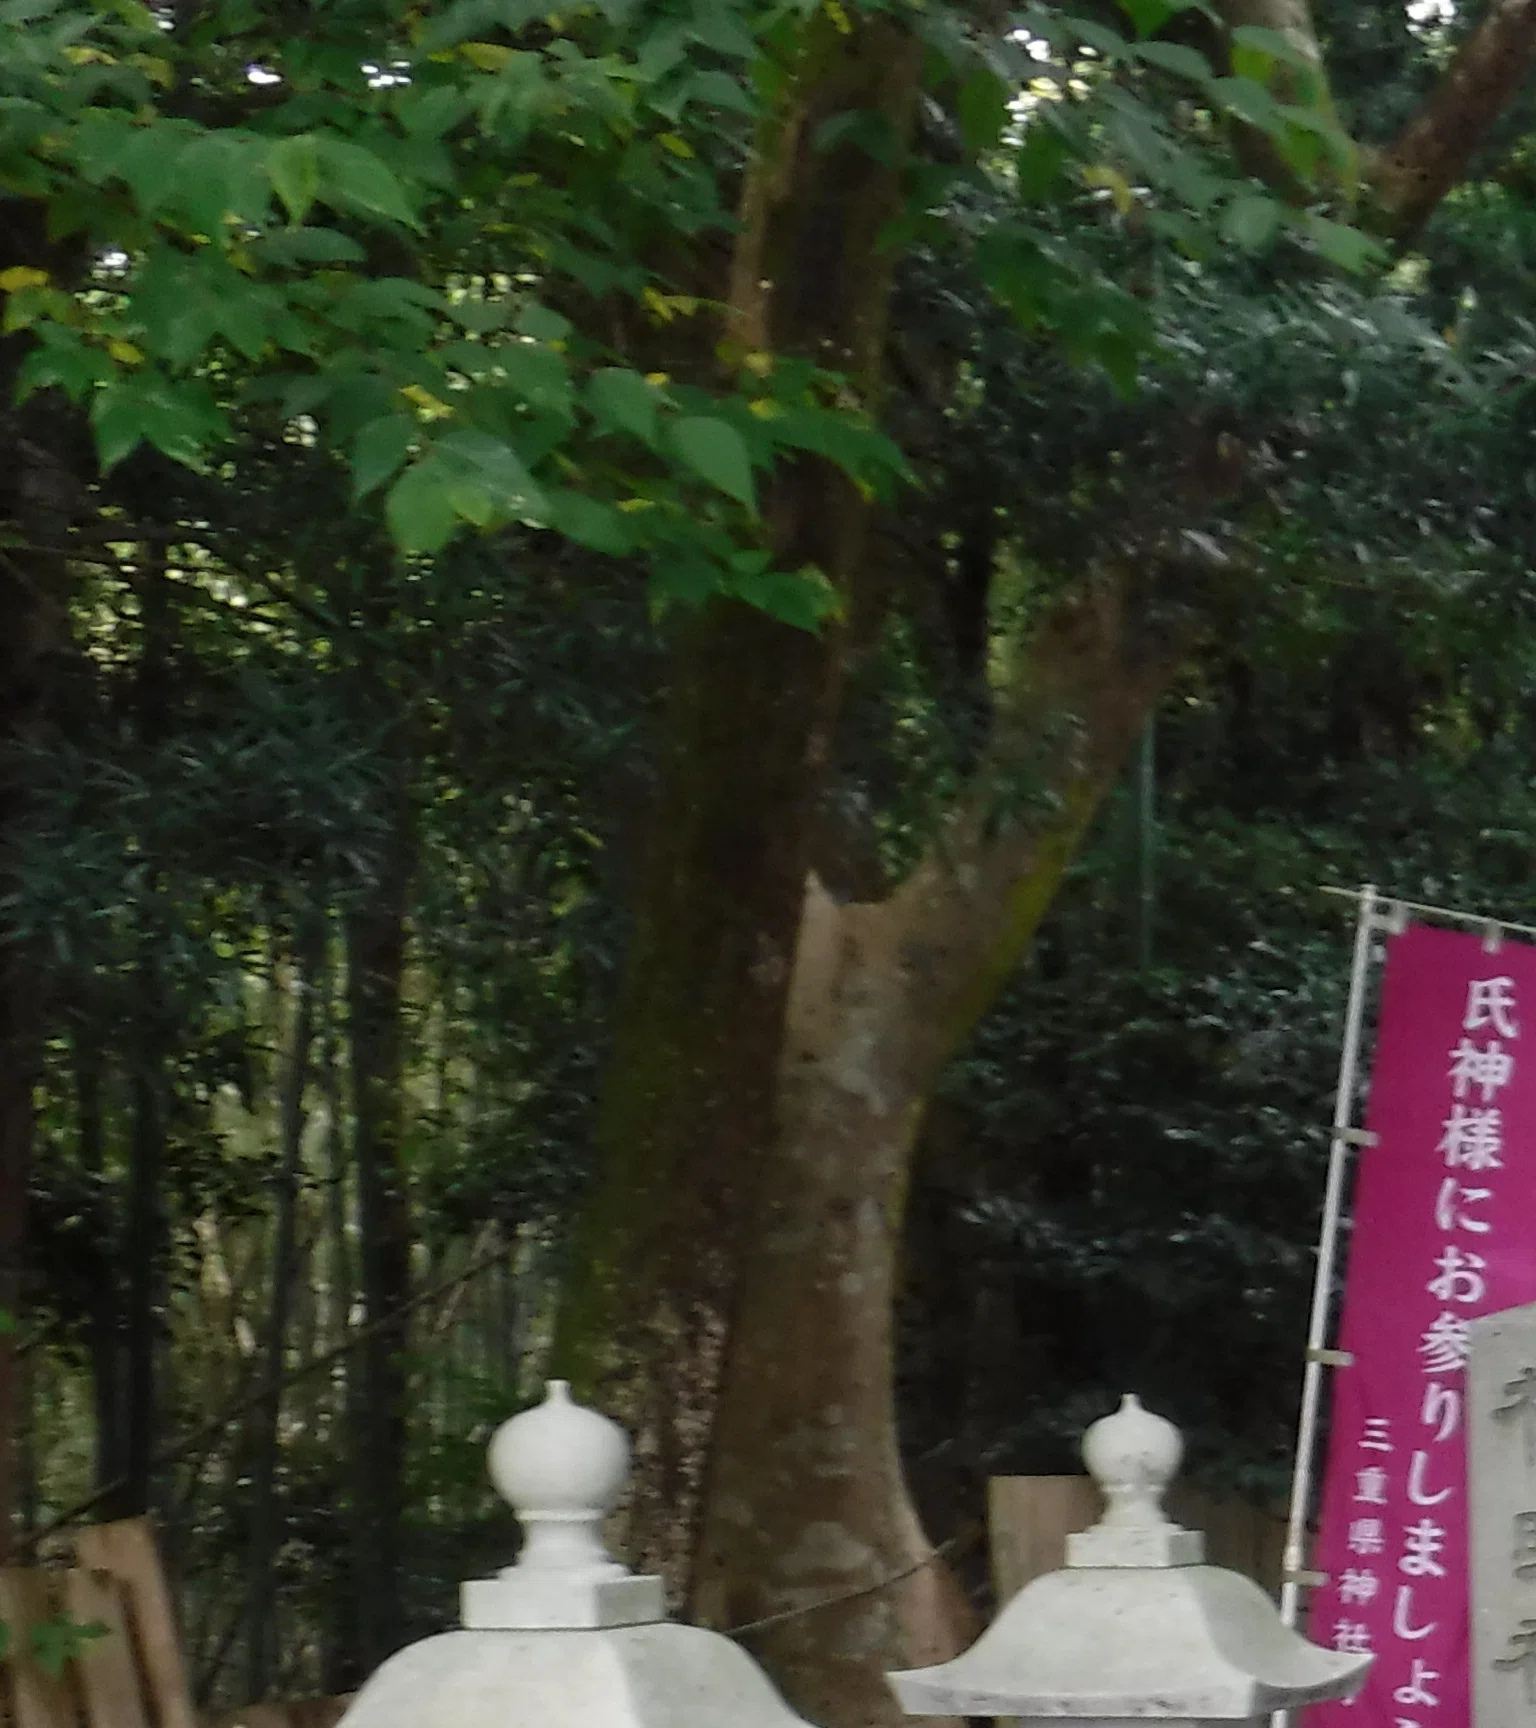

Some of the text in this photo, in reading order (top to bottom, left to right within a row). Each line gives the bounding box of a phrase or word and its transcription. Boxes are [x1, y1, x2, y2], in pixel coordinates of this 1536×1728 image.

[1332, 1417, 1395, 1707] 三重県神社
